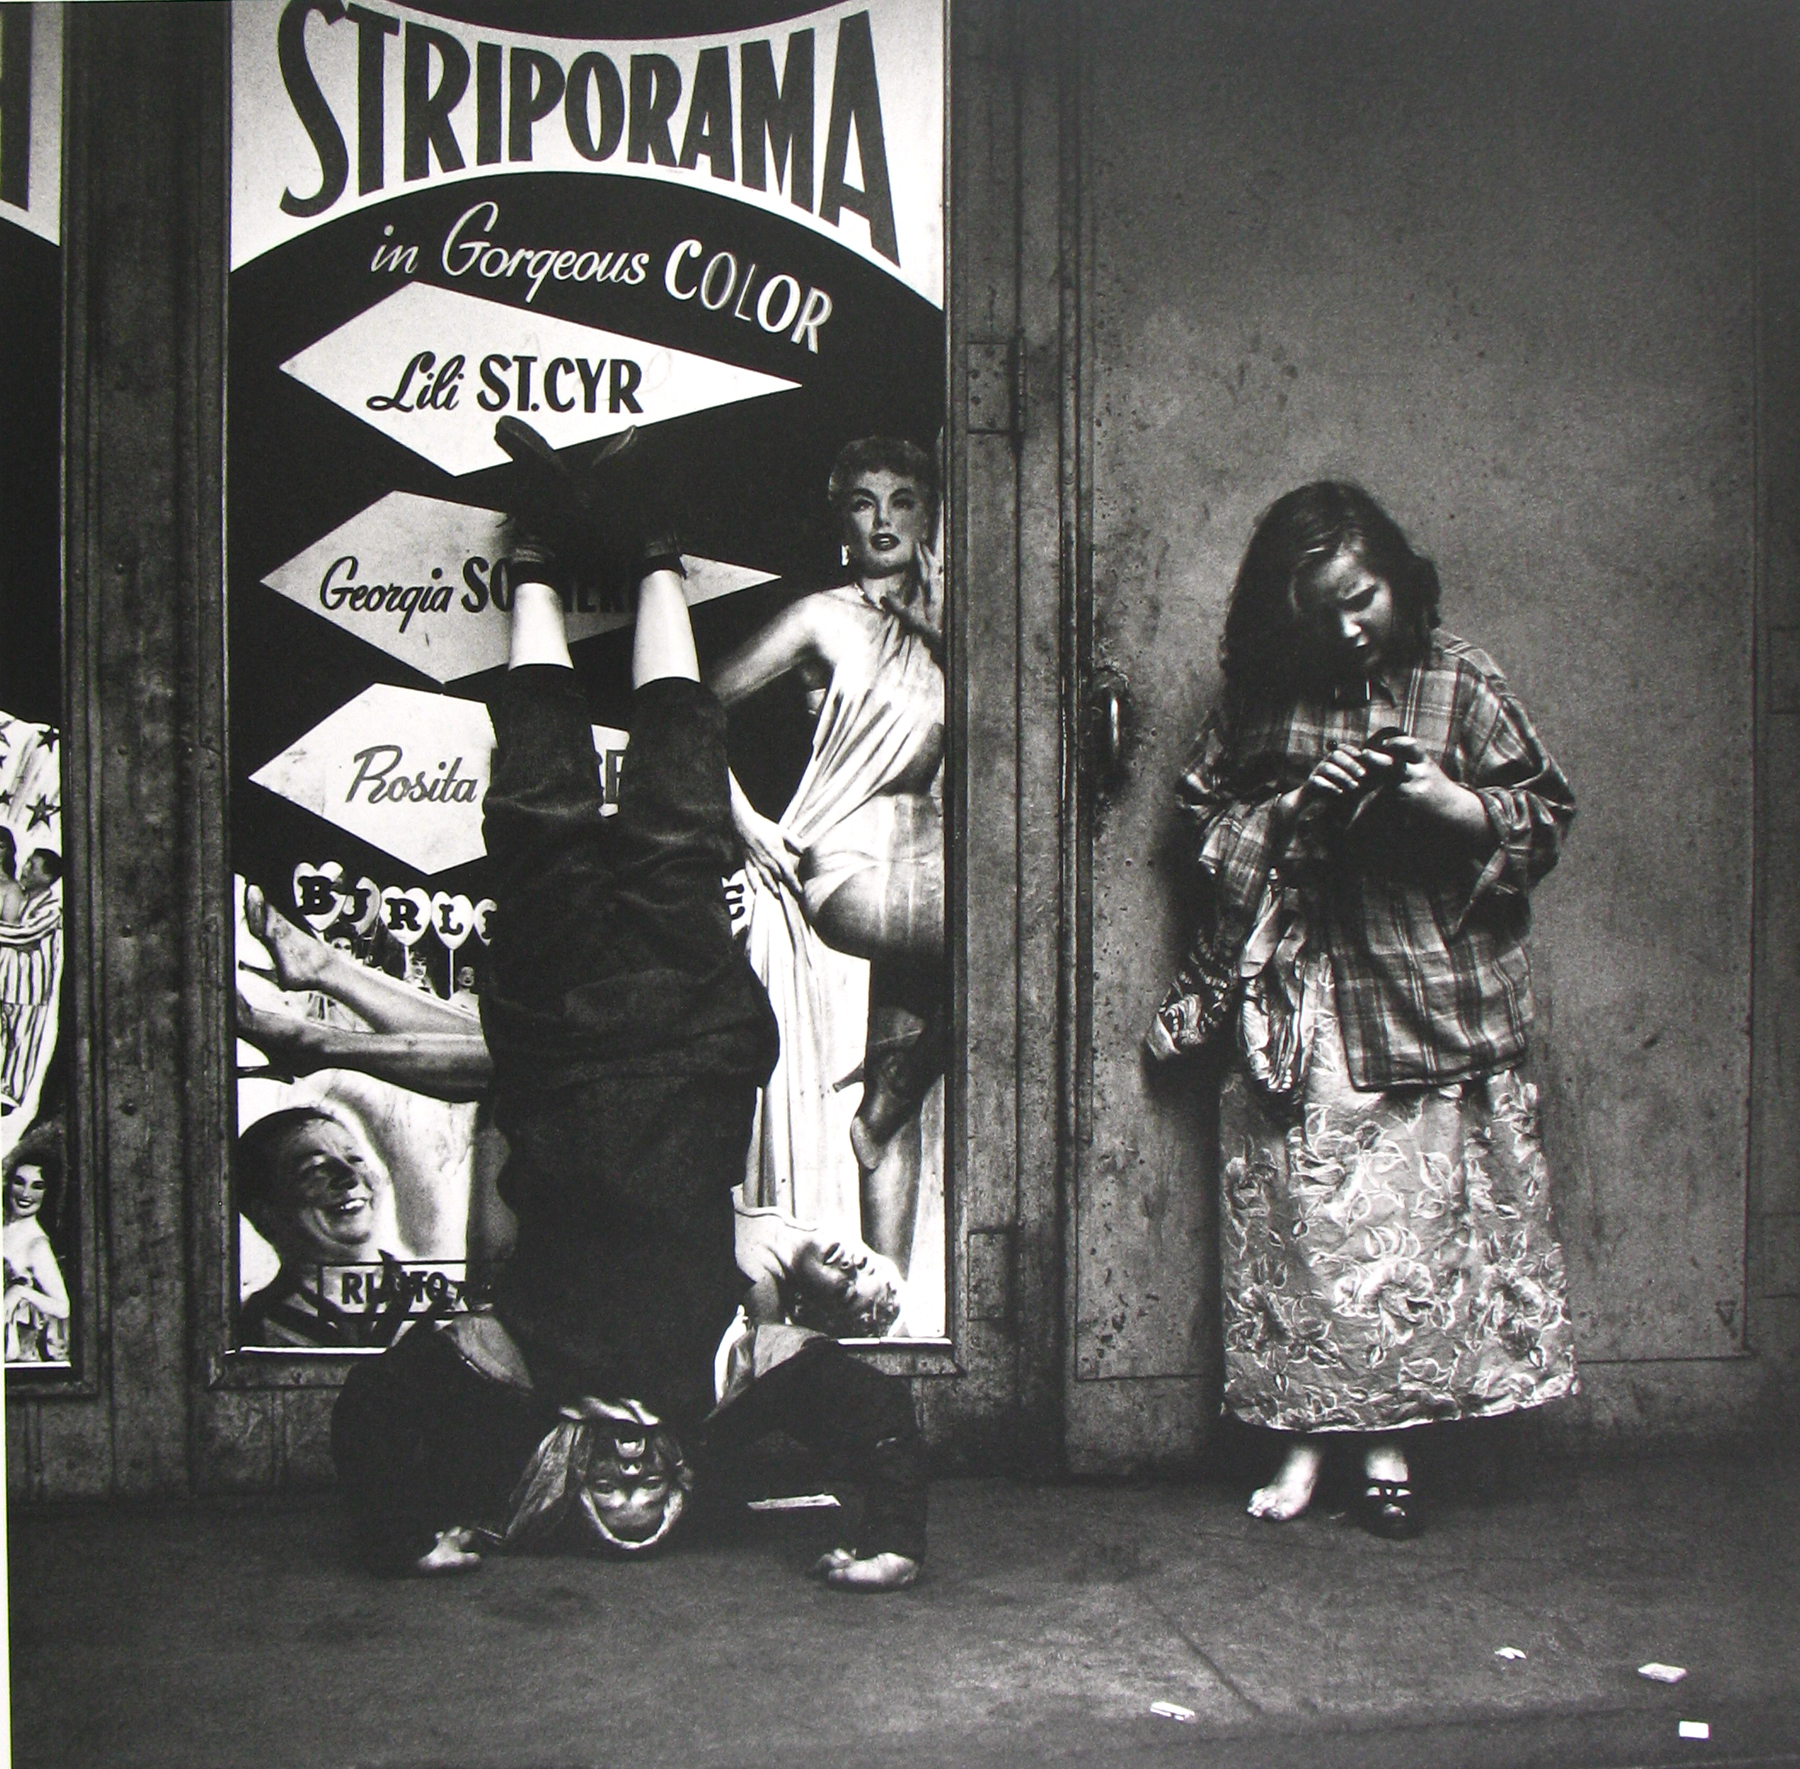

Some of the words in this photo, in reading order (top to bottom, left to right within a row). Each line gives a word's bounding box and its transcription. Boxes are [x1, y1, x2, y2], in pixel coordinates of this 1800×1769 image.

[279, 0, 901, 269] STRIPORAMA
[370, 224, 418, 274] in
[441, 201, 649, 303] Gorgeous
[664, 239, 833, 354] COLOR
[367, 351, 465, 412] Lili
[319, 556, 452, 633] Georgia
[345, 744, 476, 804] Rosita
[341, 1271, 448, 1305] RITO
